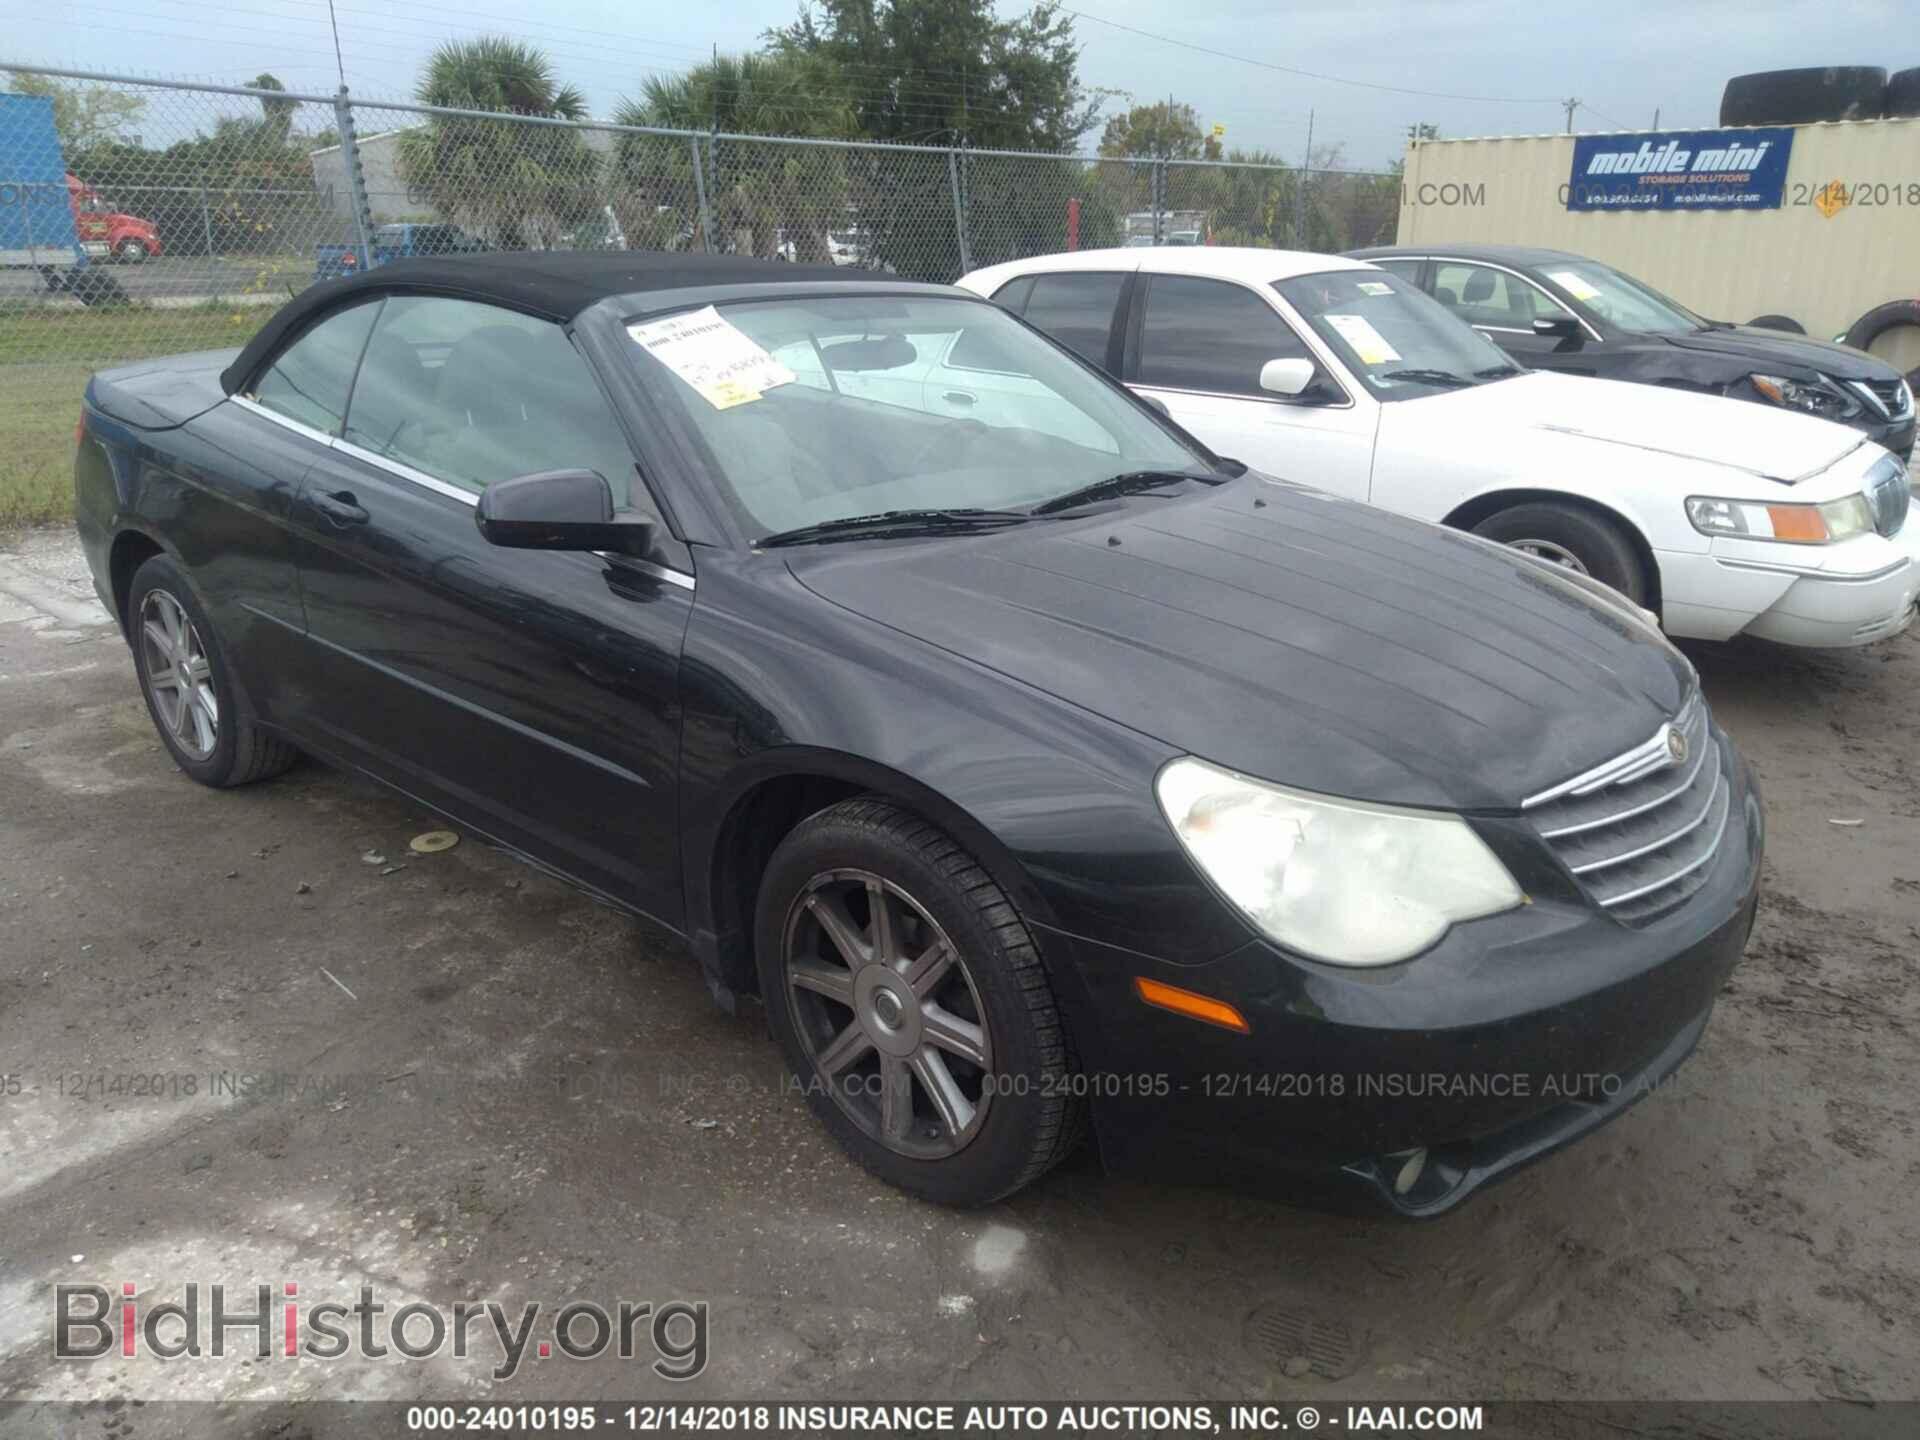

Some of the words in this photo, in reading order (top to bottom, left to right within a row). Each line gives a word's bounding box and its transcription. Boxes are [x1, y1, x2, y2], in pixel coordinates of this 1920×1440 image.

[1587, 140, 1692, 174] mobile
[1691, 141, 1770, 172] mini
[1638, 174, 1686, 185] STORAGE
[1689, 173, 1751, 184] SOLUTIONS
